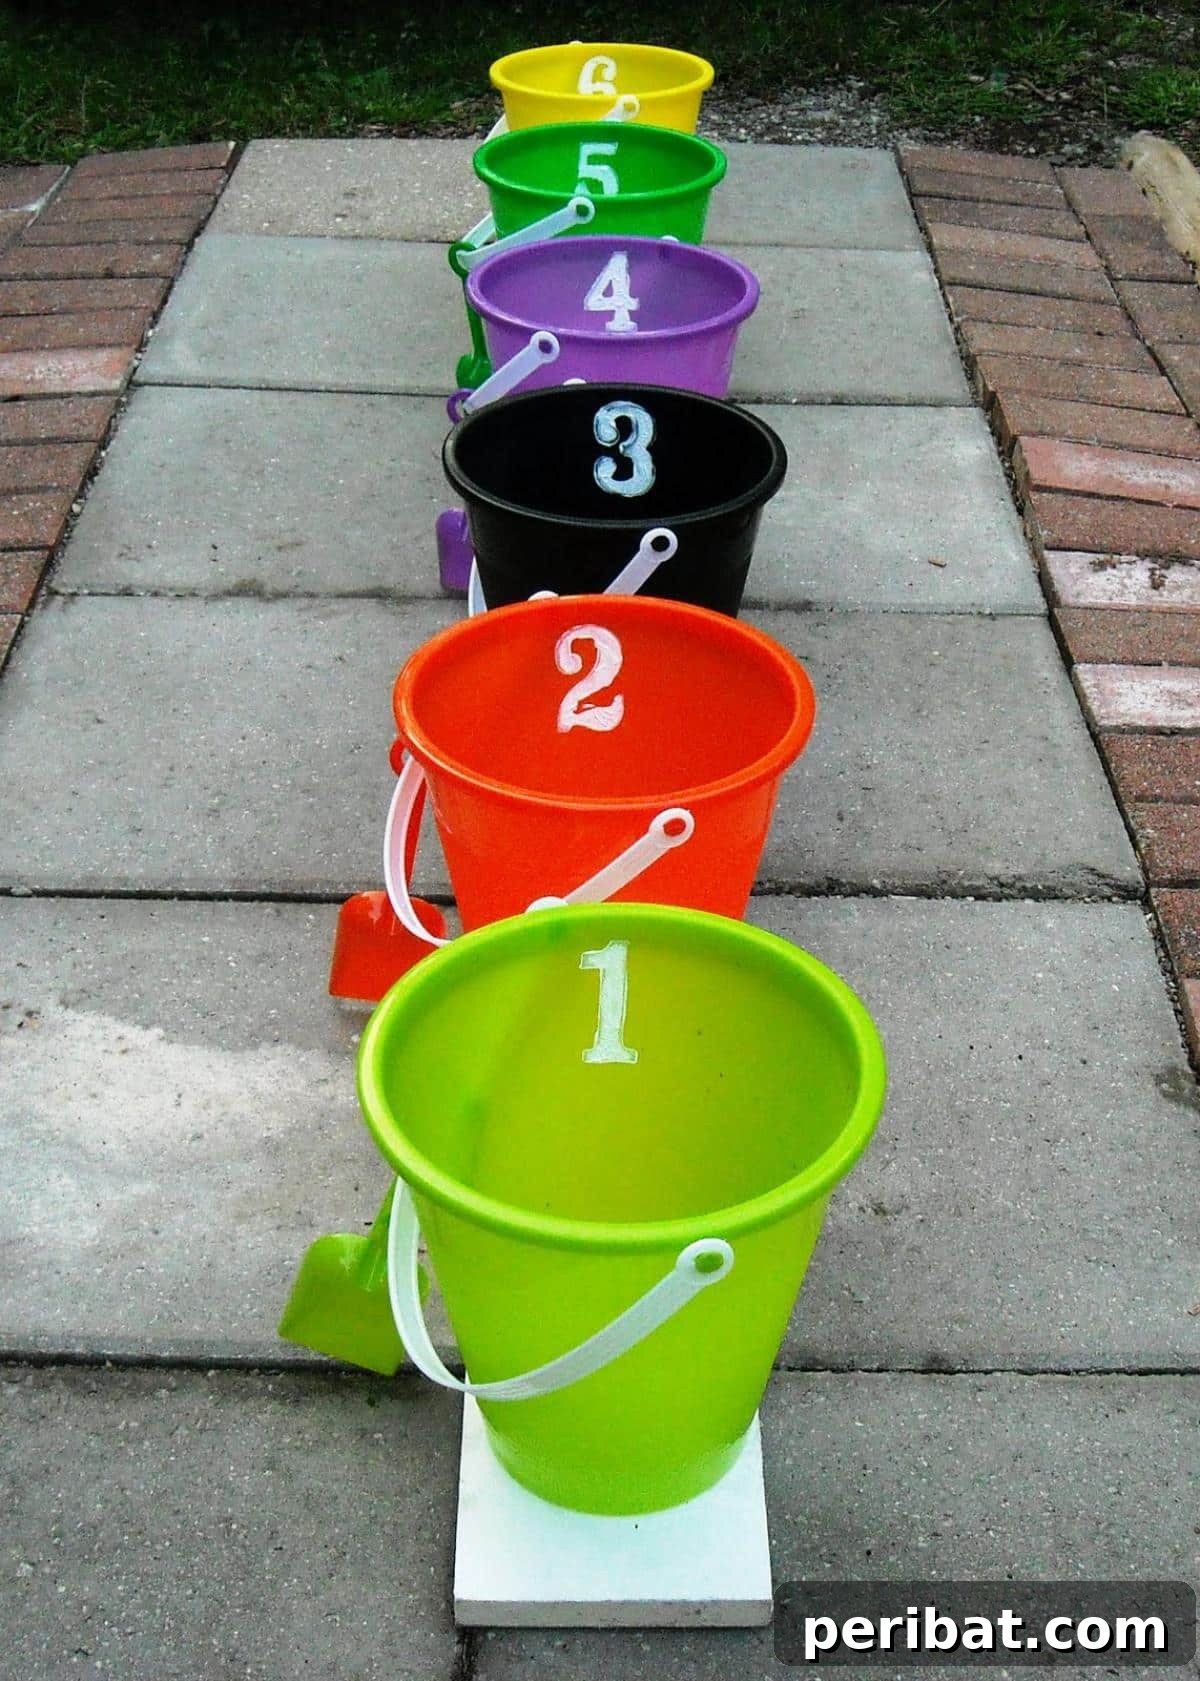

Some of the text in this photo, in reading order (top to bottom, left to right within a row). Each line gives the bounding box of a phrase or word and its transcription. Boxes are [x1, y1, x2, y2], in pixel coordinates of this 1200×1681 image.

[577, 142, 619, 196] 5
[584, 251, 640, 332] 4
[593, 400, 656, 497] 3
[554, 624, 624, 733] 2
[579, 940, 638, 1064] 1
